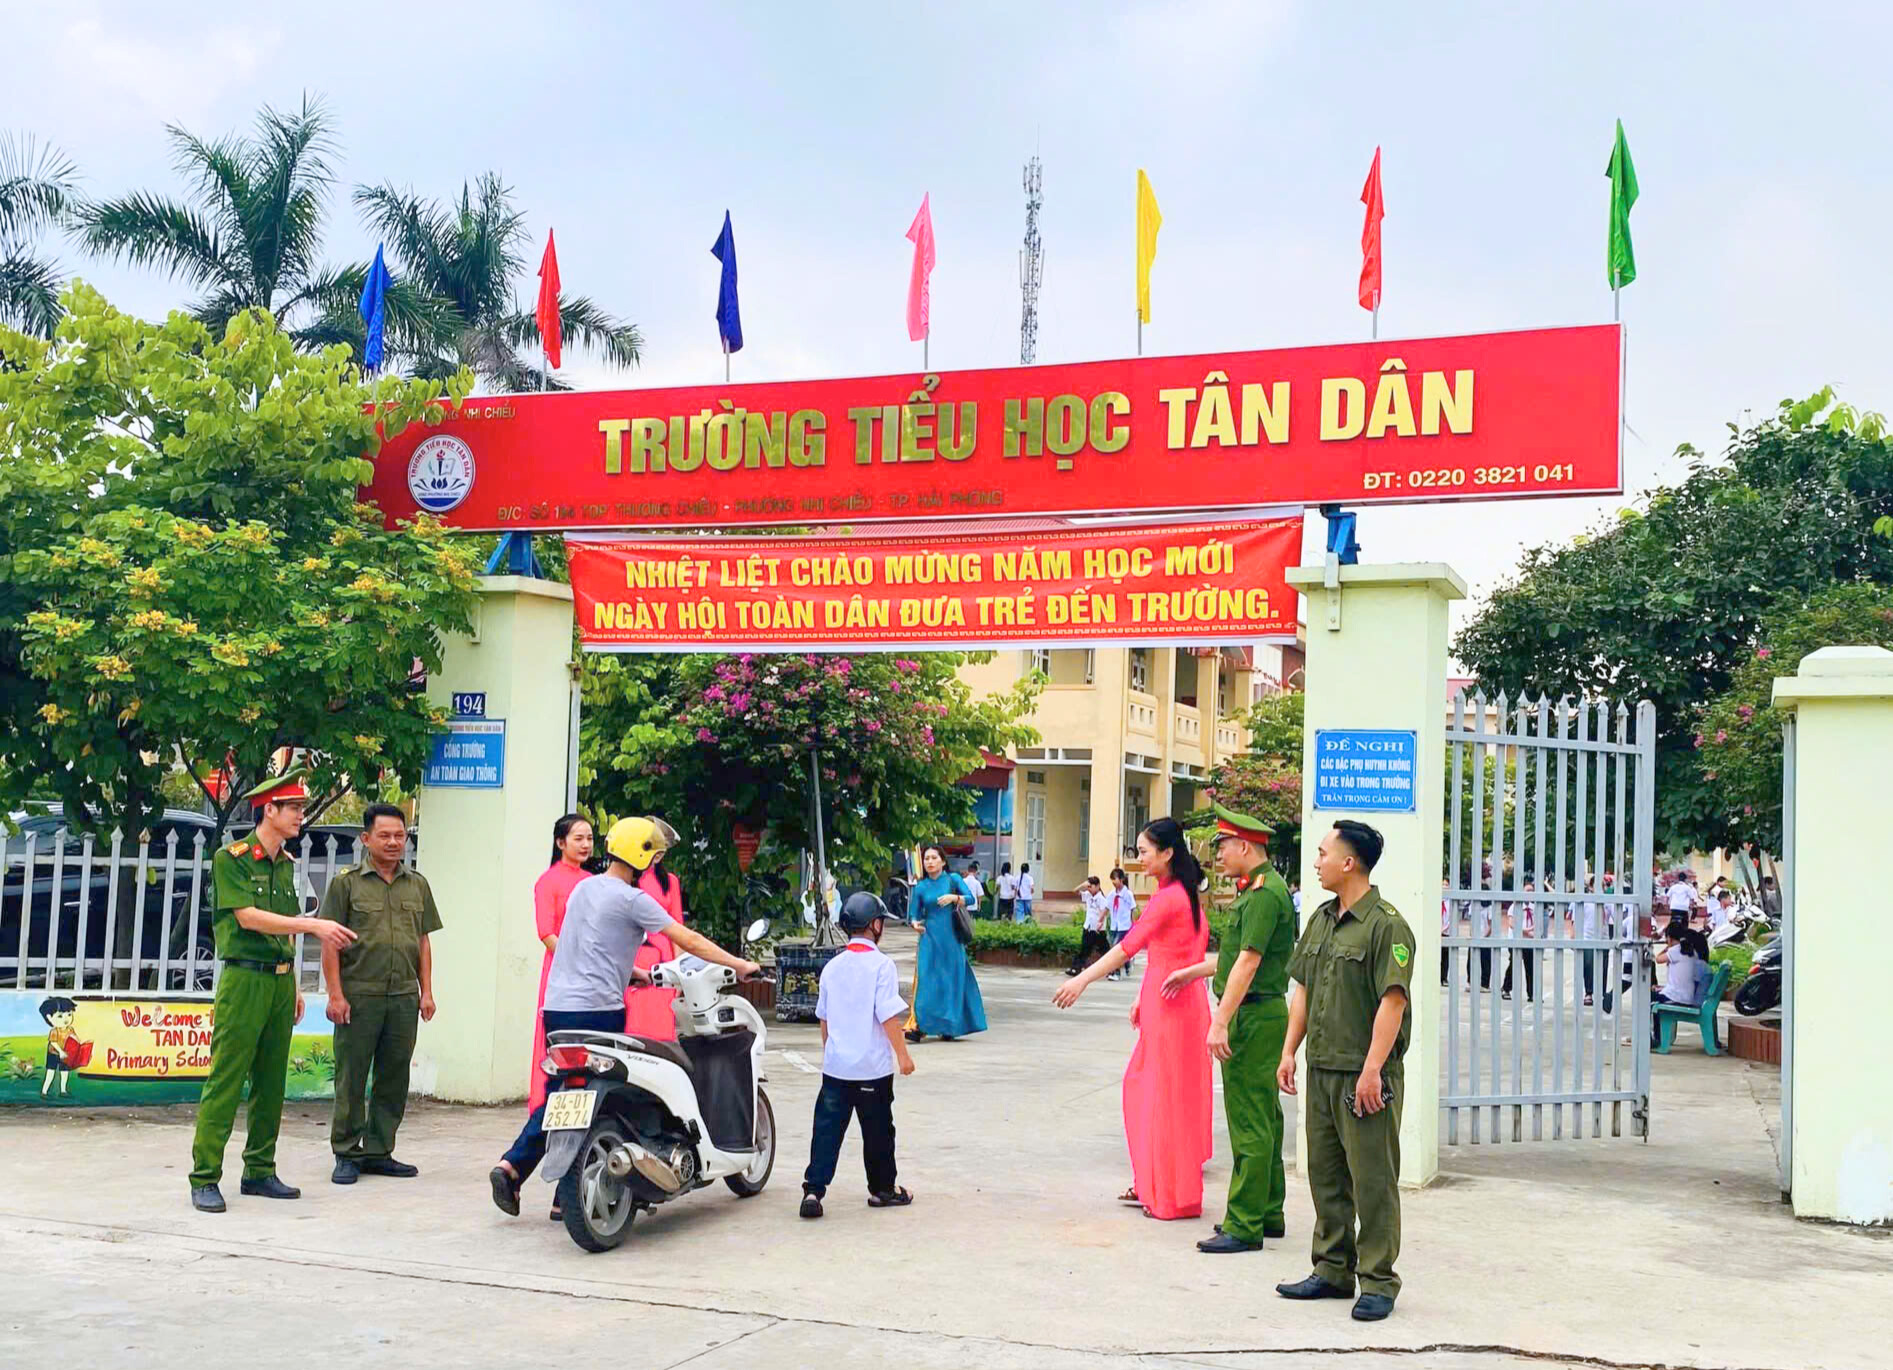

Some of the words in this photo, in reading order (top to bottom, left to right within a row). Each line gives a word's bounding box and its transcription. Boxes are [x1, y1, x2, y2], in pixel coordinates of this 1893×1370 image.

[598, 399, 827, 475] TRƯỜNG
[847, 374, 978, 465] TIỂU
[1003, 390, 1131, 470] HỌC
[1159, 370, 1291, 449] TÂN
[1319, 358, 1475, 441] DÂN
[1363, 472, 1401, 490] ĐT:
[1408, 468, 1465, 488] 0220
[1473, 466, 1530, 485] 3821
[1534, 463, 1575, 482] 041
[625, 555, 710, 593] NHIỆT
[720, 553, 780, 592] LIỆT
[791, 552, 873, 587] CHÀO
[885, 549, 981, 585] MỪNG
[993, 546, 1071, 582] NĂM
[1084, 547, 1152, 585] HỌC
[1165, 538, 1234, 576] MỚI
[594, 597, 667, 630] NGÀY
[677, 596, 726, 638] HỘI
[735, 595, 815, 629] TOÀN
[825, 594, 890, 629] DÂN
[899, 593, 965, 629] ĐƯA
[976, 586, 1036, 626] TRẺ
[1046, 584, 1116, 625] ĐẾN
[1127, 583, 1279, 623] TRƯỜNG.
[454, 695, 483, 714] 194
[1325, 737, 1350, 751] ĐỀ
[1355, 741, 1404, 754] NGHỊ
[458, 766, 475, 781] GIAO
[1320, 757, 1334, 770] CÁC
[1349, 759, 1364, 773] PHỤ
[1364, 759, 1387, 771] HUYNH
[1388, 757, 1411, 771] KHÔNG
[1329, 776, 1339, 788] XE
[1340, 774, 1355, 789] VÀO
[1356, 777, 1380, 789] TRONG
[1381, 775, 1411, 790] TRƯỜNG
[121, 1005, 203, 1029] Welcome
[150, 1029, 184, 1047] TAN
[107, 1048, 169, 1075] Primary
